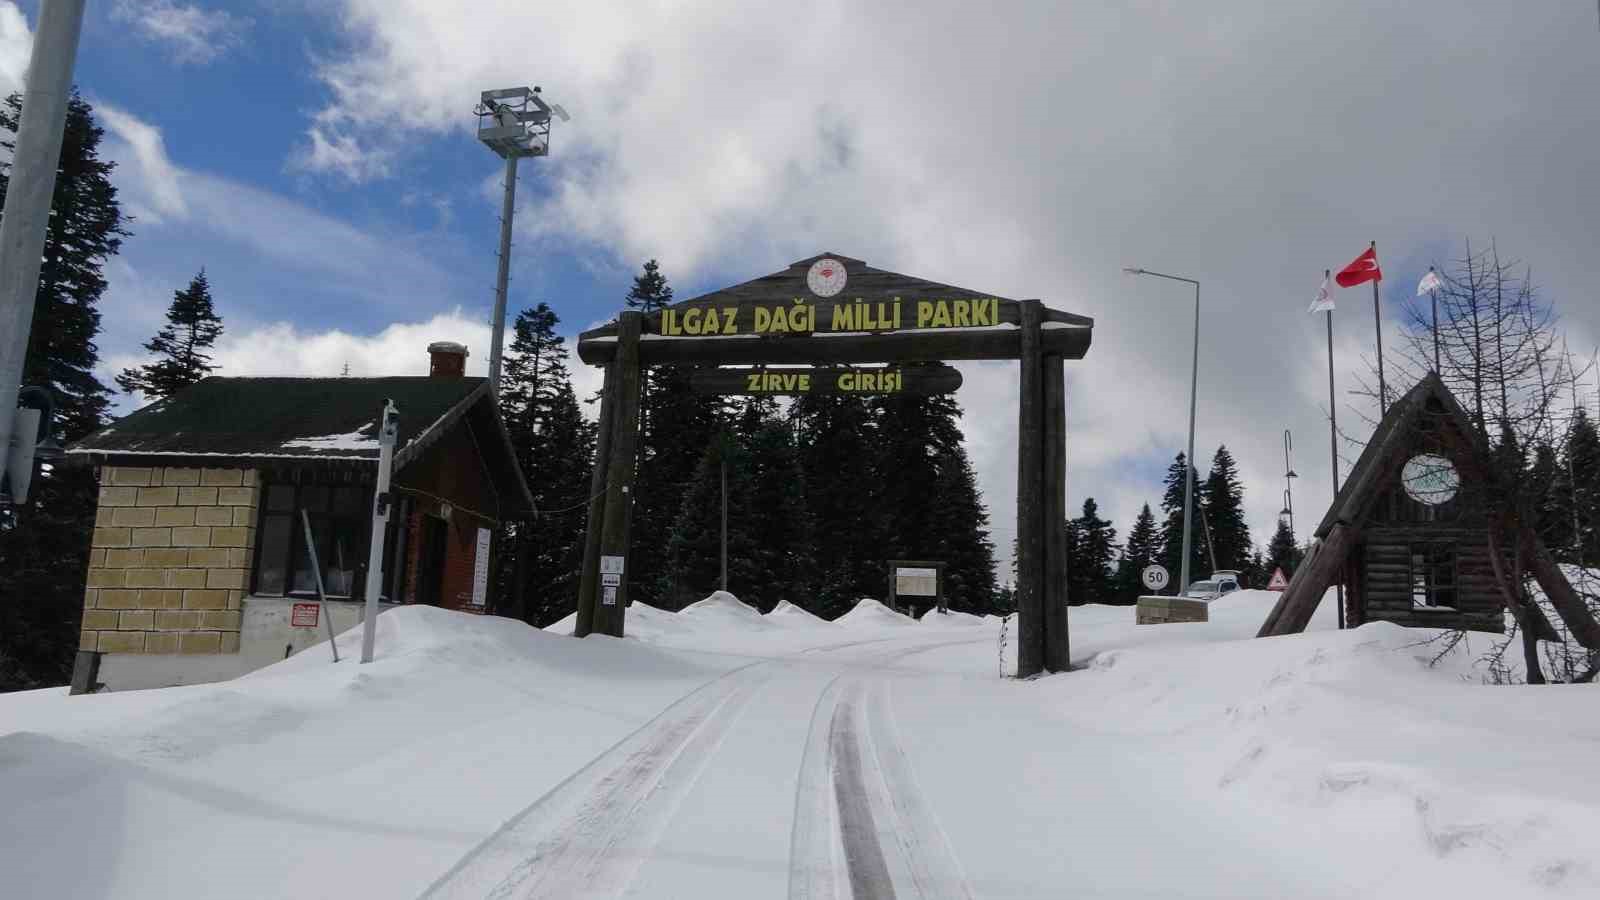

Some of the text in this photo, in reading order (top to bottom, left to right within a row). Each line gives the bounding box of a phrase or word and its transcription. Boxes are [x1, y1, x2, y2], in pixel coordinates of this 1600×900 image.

[661, 297, 1000, 336] ILGAZ DAĞI MİLLİ PARKI
[747, 369, 902, 393] ZİRVE GİRİŞİ
[1149, 572, 1163, 583] 50
